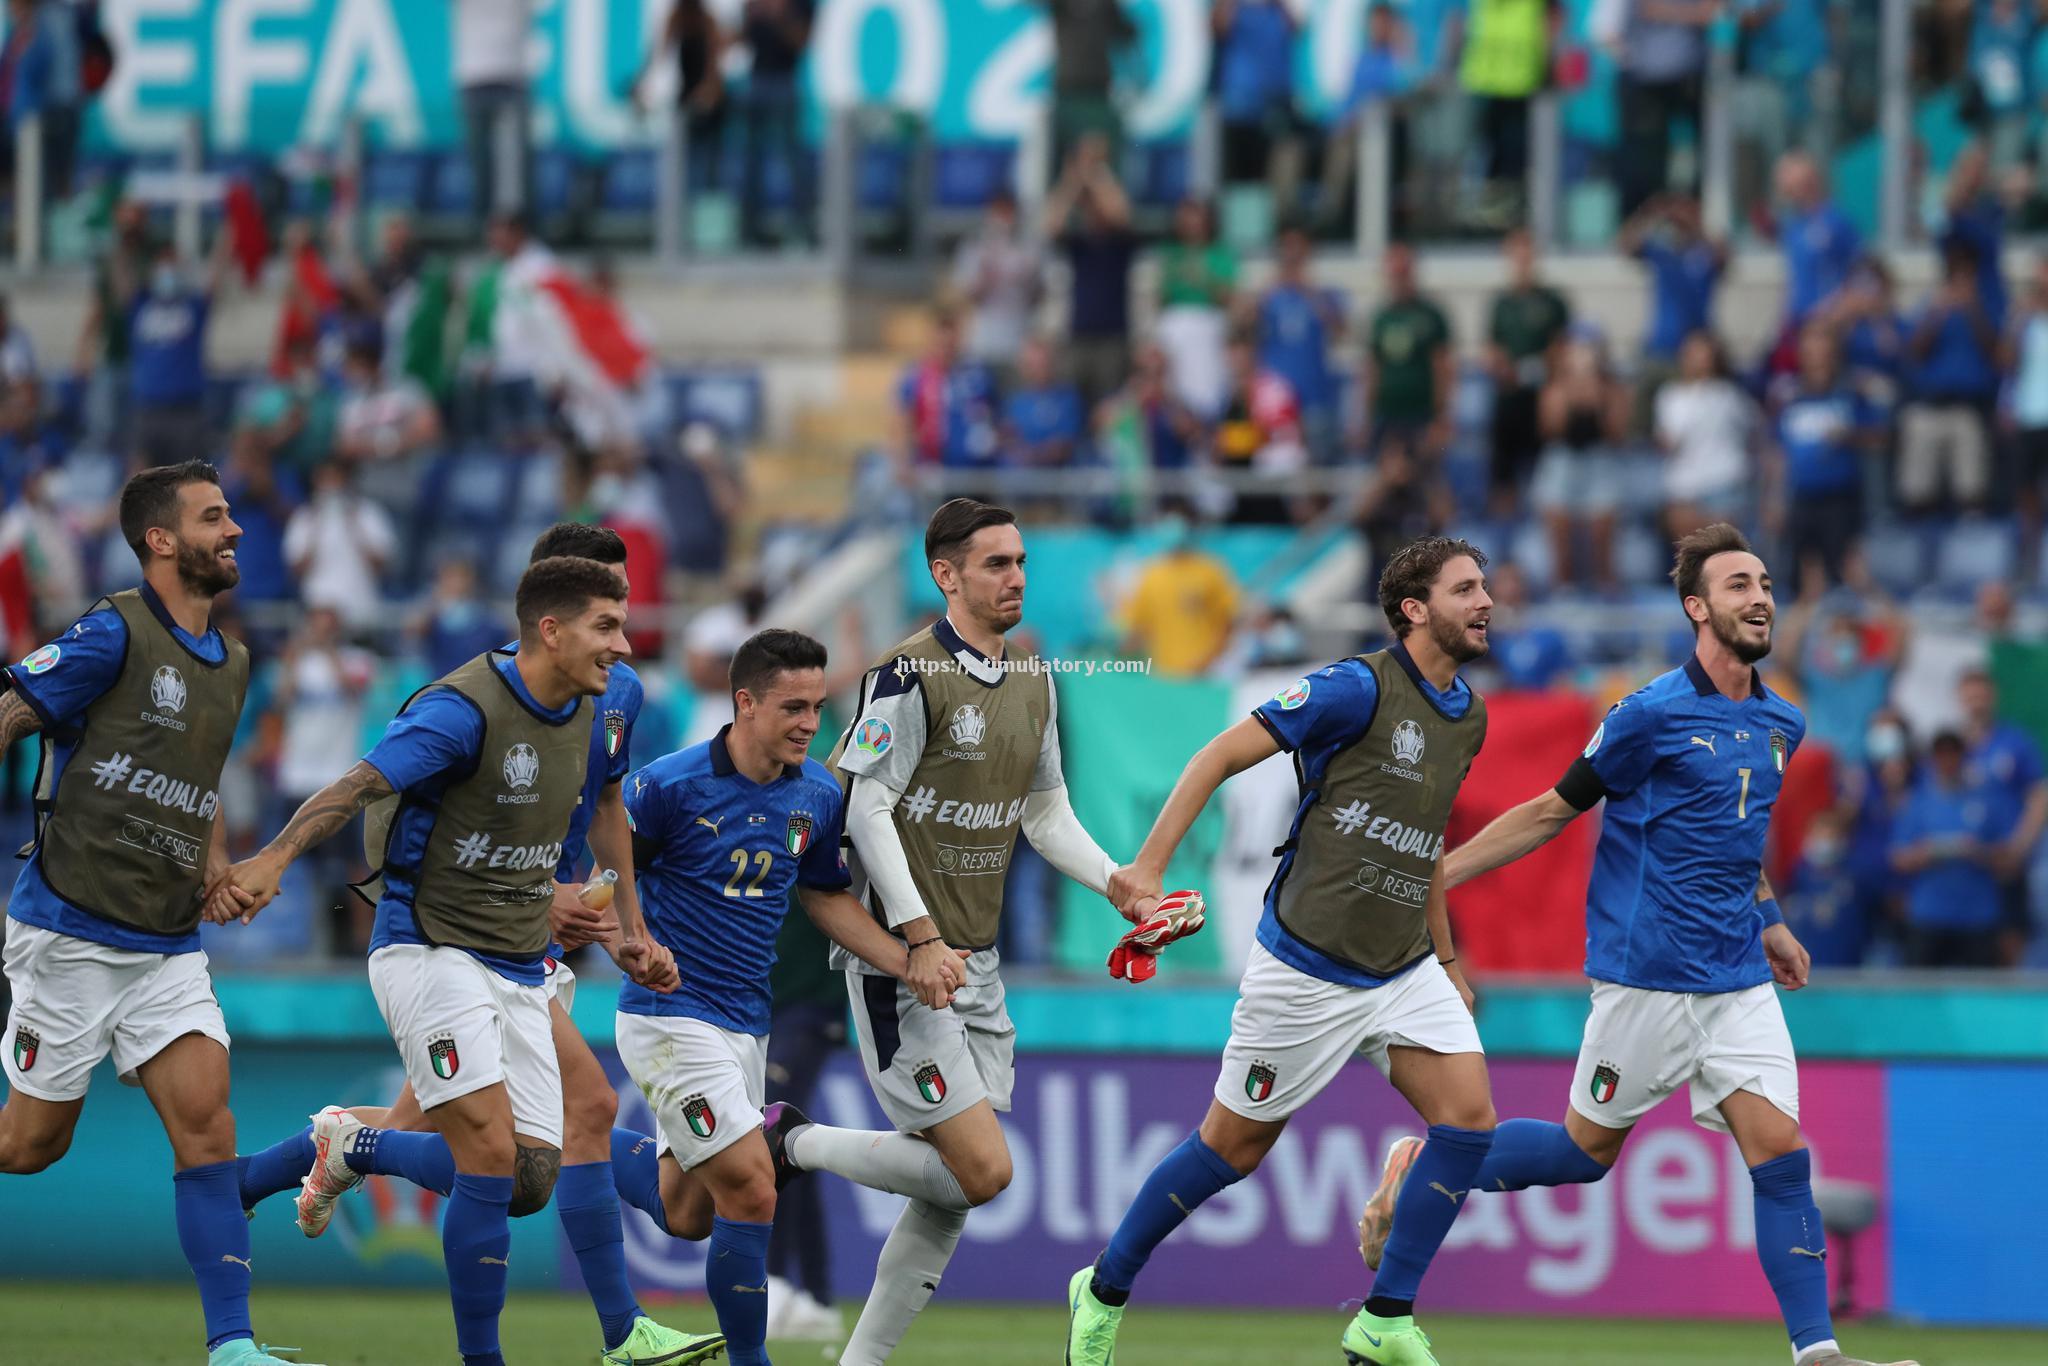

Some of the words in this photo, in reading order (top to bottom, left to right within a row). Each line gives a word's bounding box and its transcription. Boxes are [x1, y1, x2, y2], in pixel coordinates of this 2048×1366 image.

[103, 0, 426, 152] EFA
[942, 748, 987, 760] EURO2020
[1380, 763, 1424, 782] EURO2020
[790, 820, 811, 828] ITALIA
[151, 832, 200, 861] RESPECT
[960, 848, 1007, 869] RESPEC
[723, 848, 773, 897] 22
[430, 1041, 454, 1053] ITALIA
